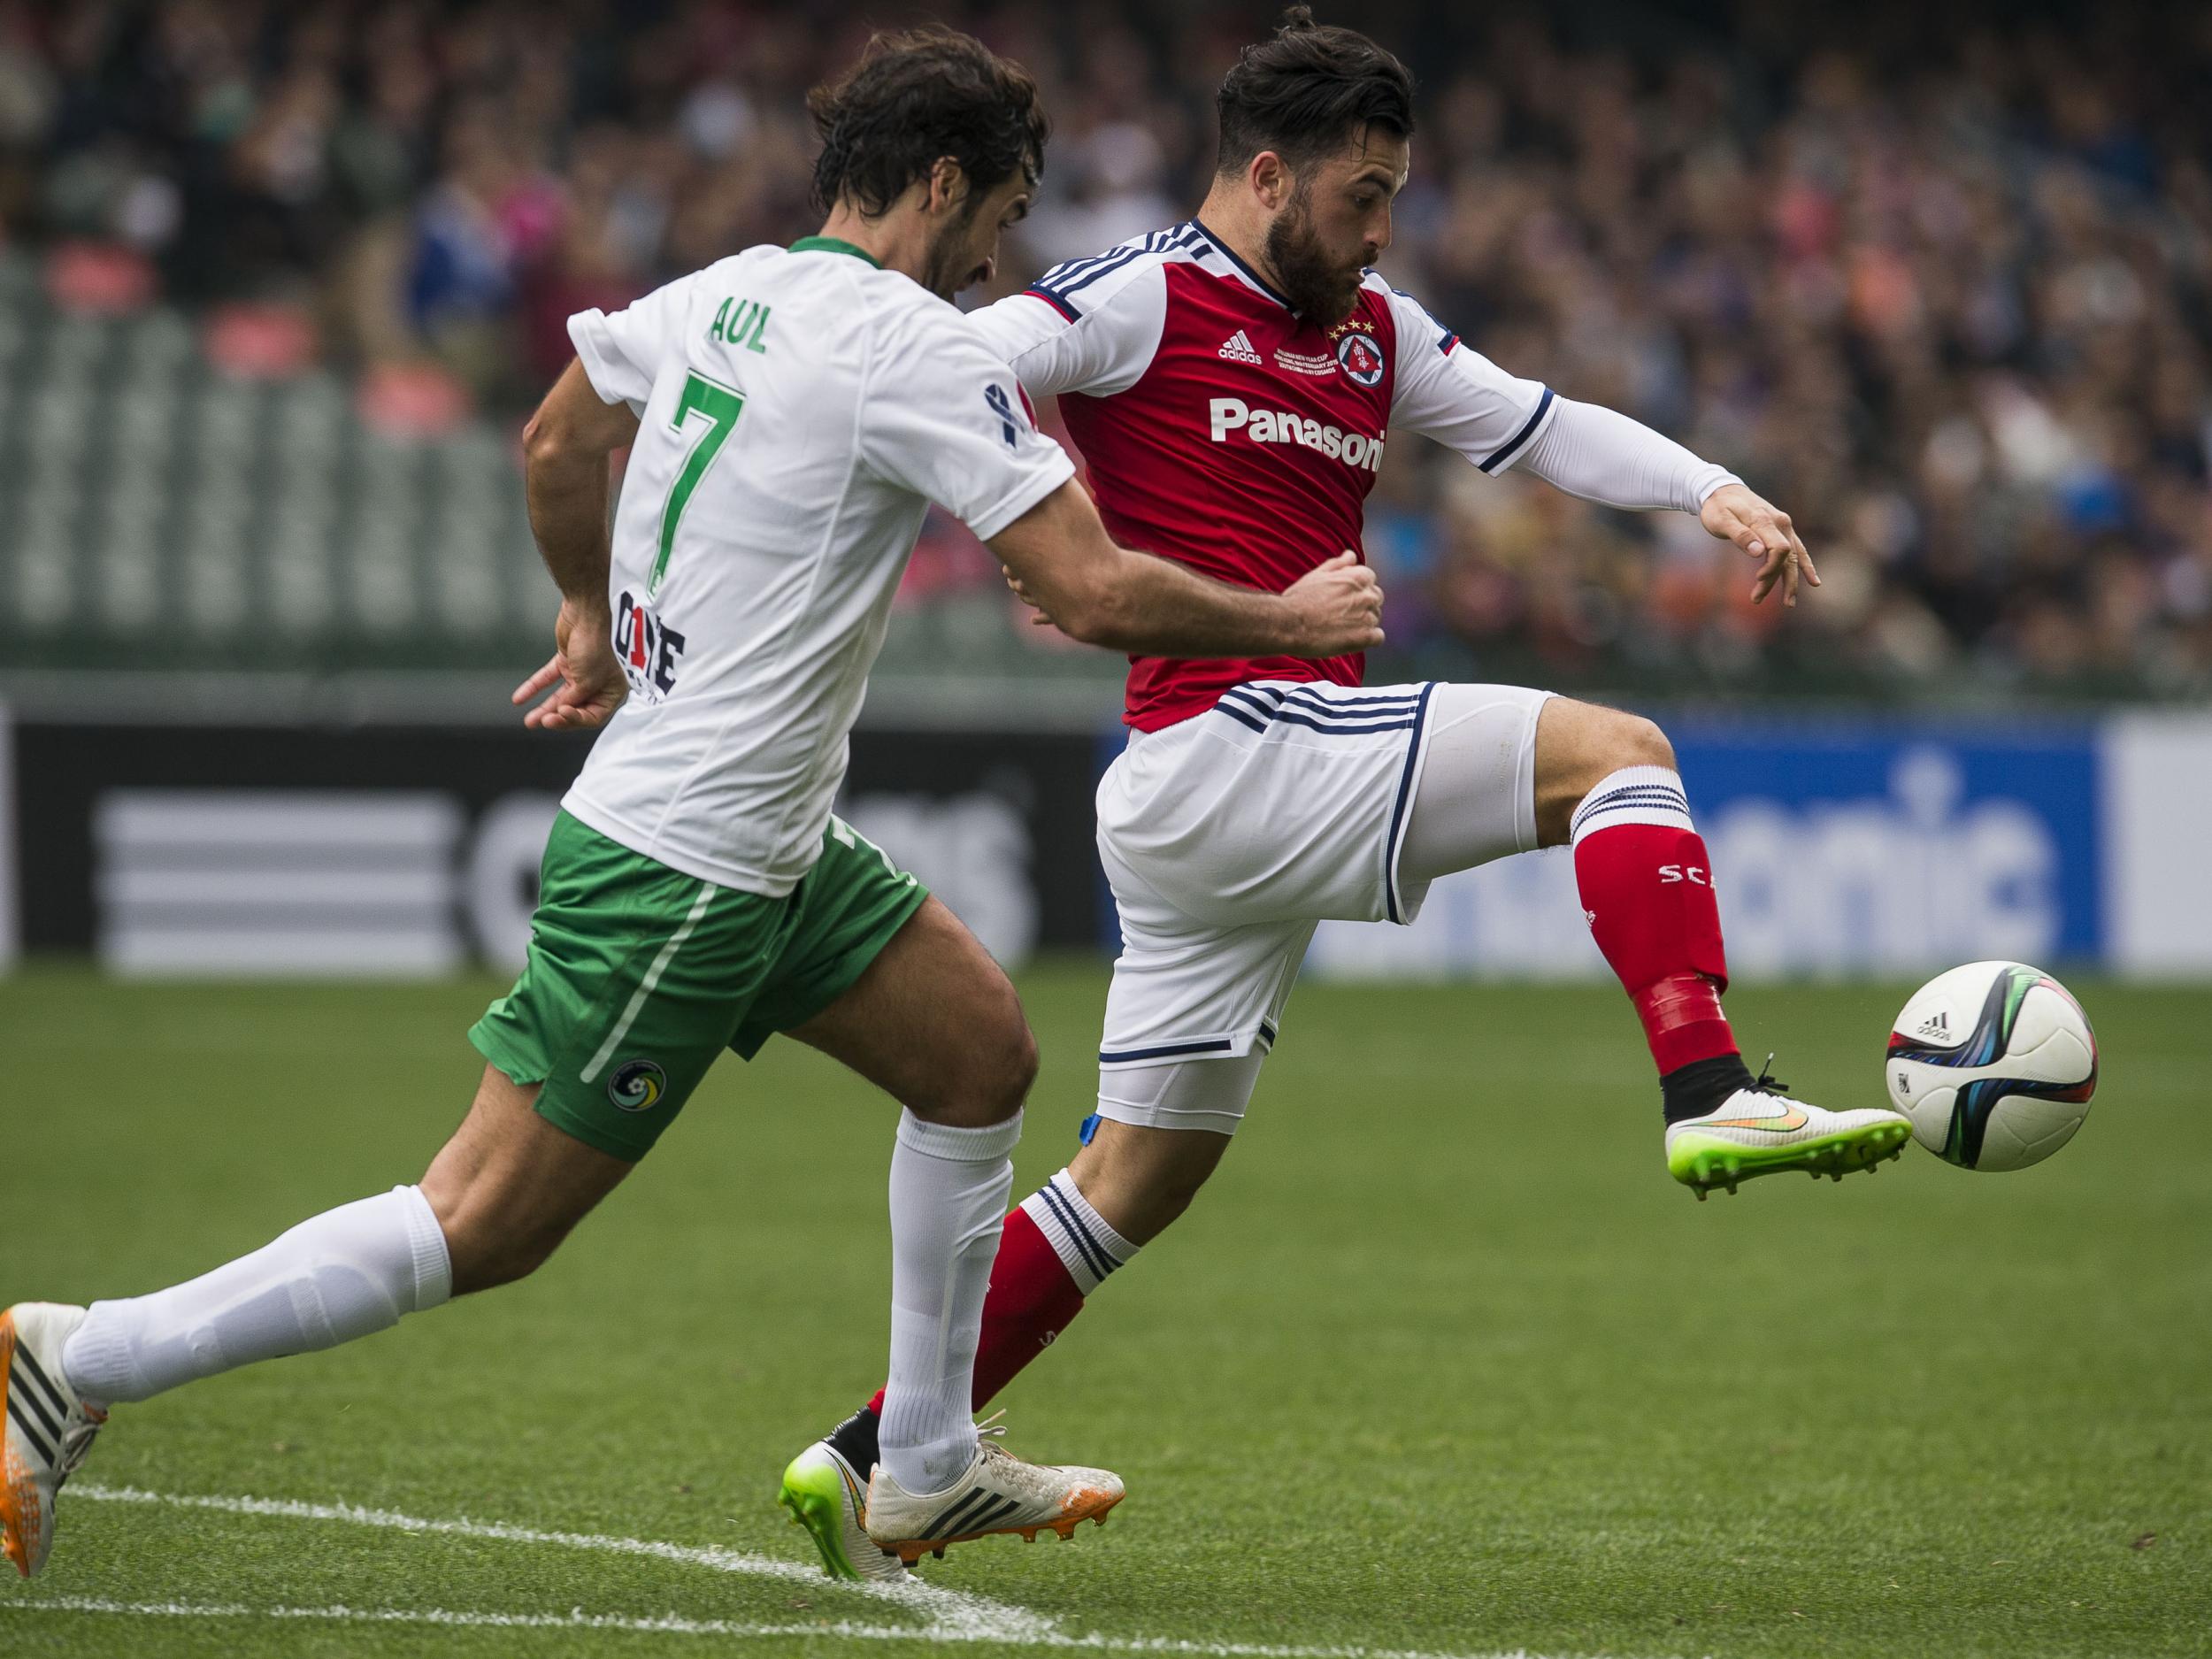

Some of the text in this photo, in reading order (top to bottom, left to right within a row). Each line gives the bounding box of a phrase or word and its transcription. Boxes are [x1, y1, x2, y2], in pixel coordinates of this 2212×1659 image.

[1218, 348, 1263, 365] adidas
[1317, 353, 1328, 363] CUP
[1210, 398, 1385, 473] Panasoni
[646, 367, 747, 603] 7
[1916, 1025, 1951, 1041] adidas
